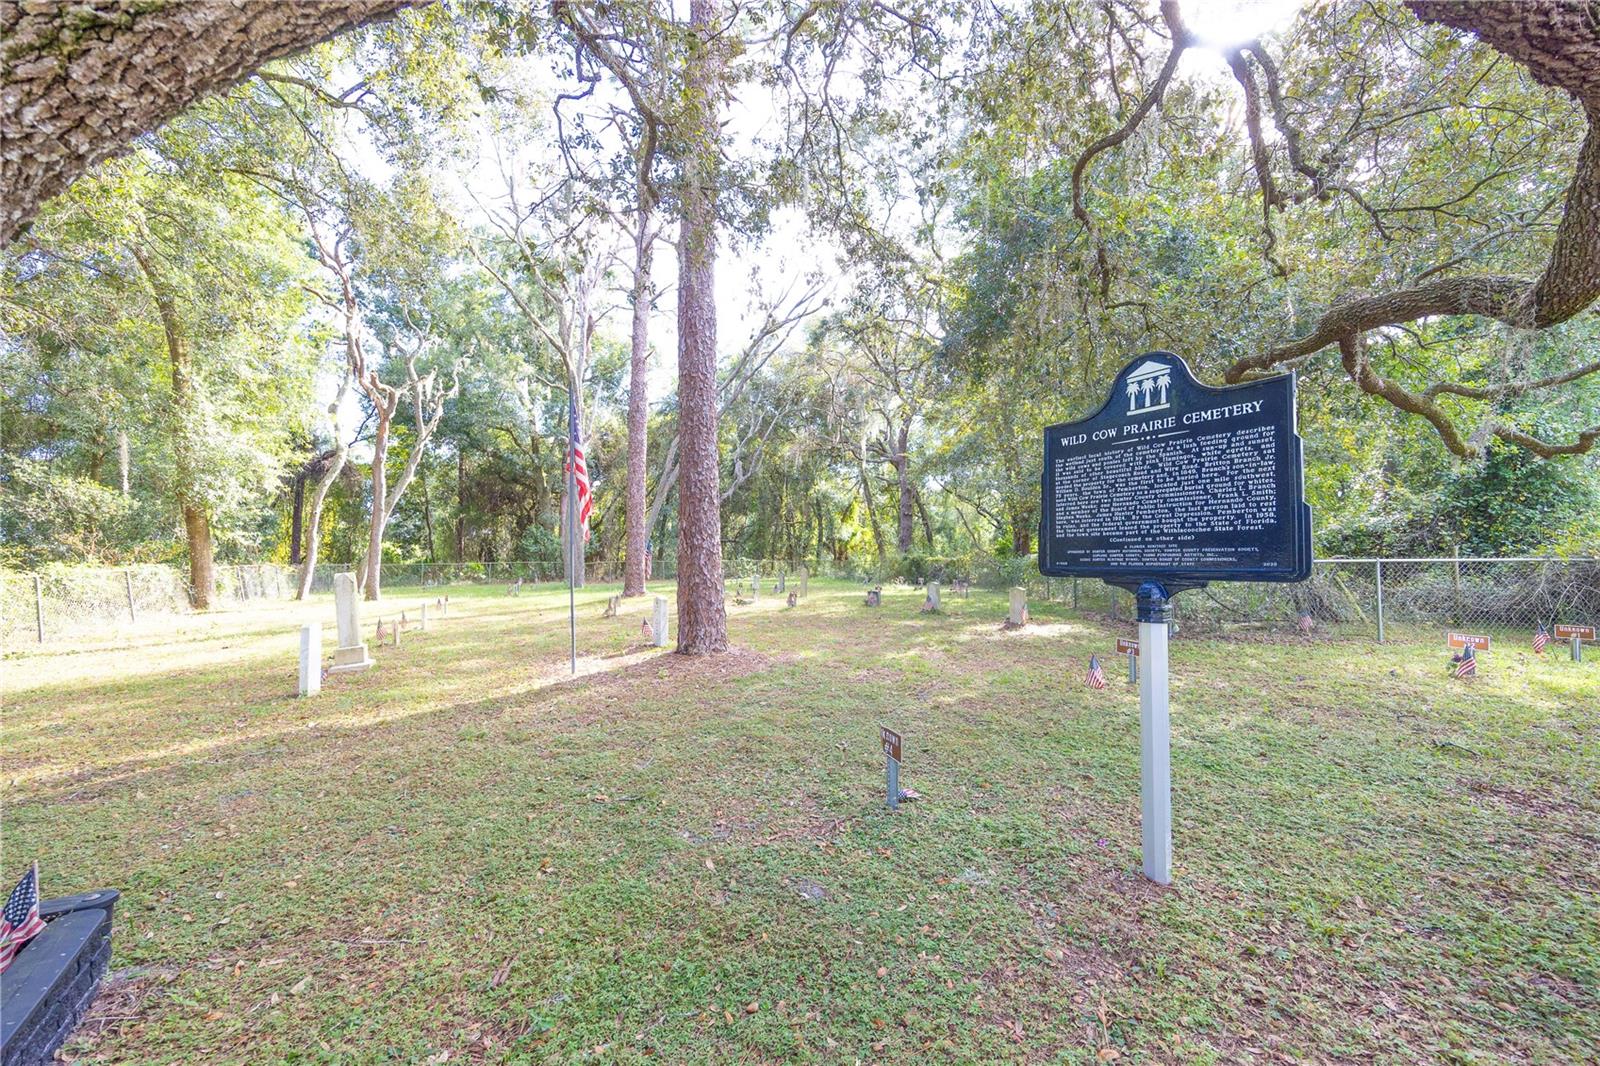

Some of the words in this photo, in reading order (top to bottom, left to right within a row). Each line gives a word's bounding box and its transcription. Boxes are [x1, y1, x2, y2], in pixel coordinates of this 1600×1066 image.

[1061, 434, 1087, 447] WILD
[1092, 428, 1117, 440] COW
[1124, 417, 1176, 435] PRAIRIE
[1184, 400, 1263, 424] CEMETERY
[1197, 432, 1230, 442] Cemetery
[1236, 425, 1274, 435] describes
[1200, 438, 1227, 447] feeding
[1231, 433, 1258, 442] ground
[1221, 450, 1258, 460] Cemetery
